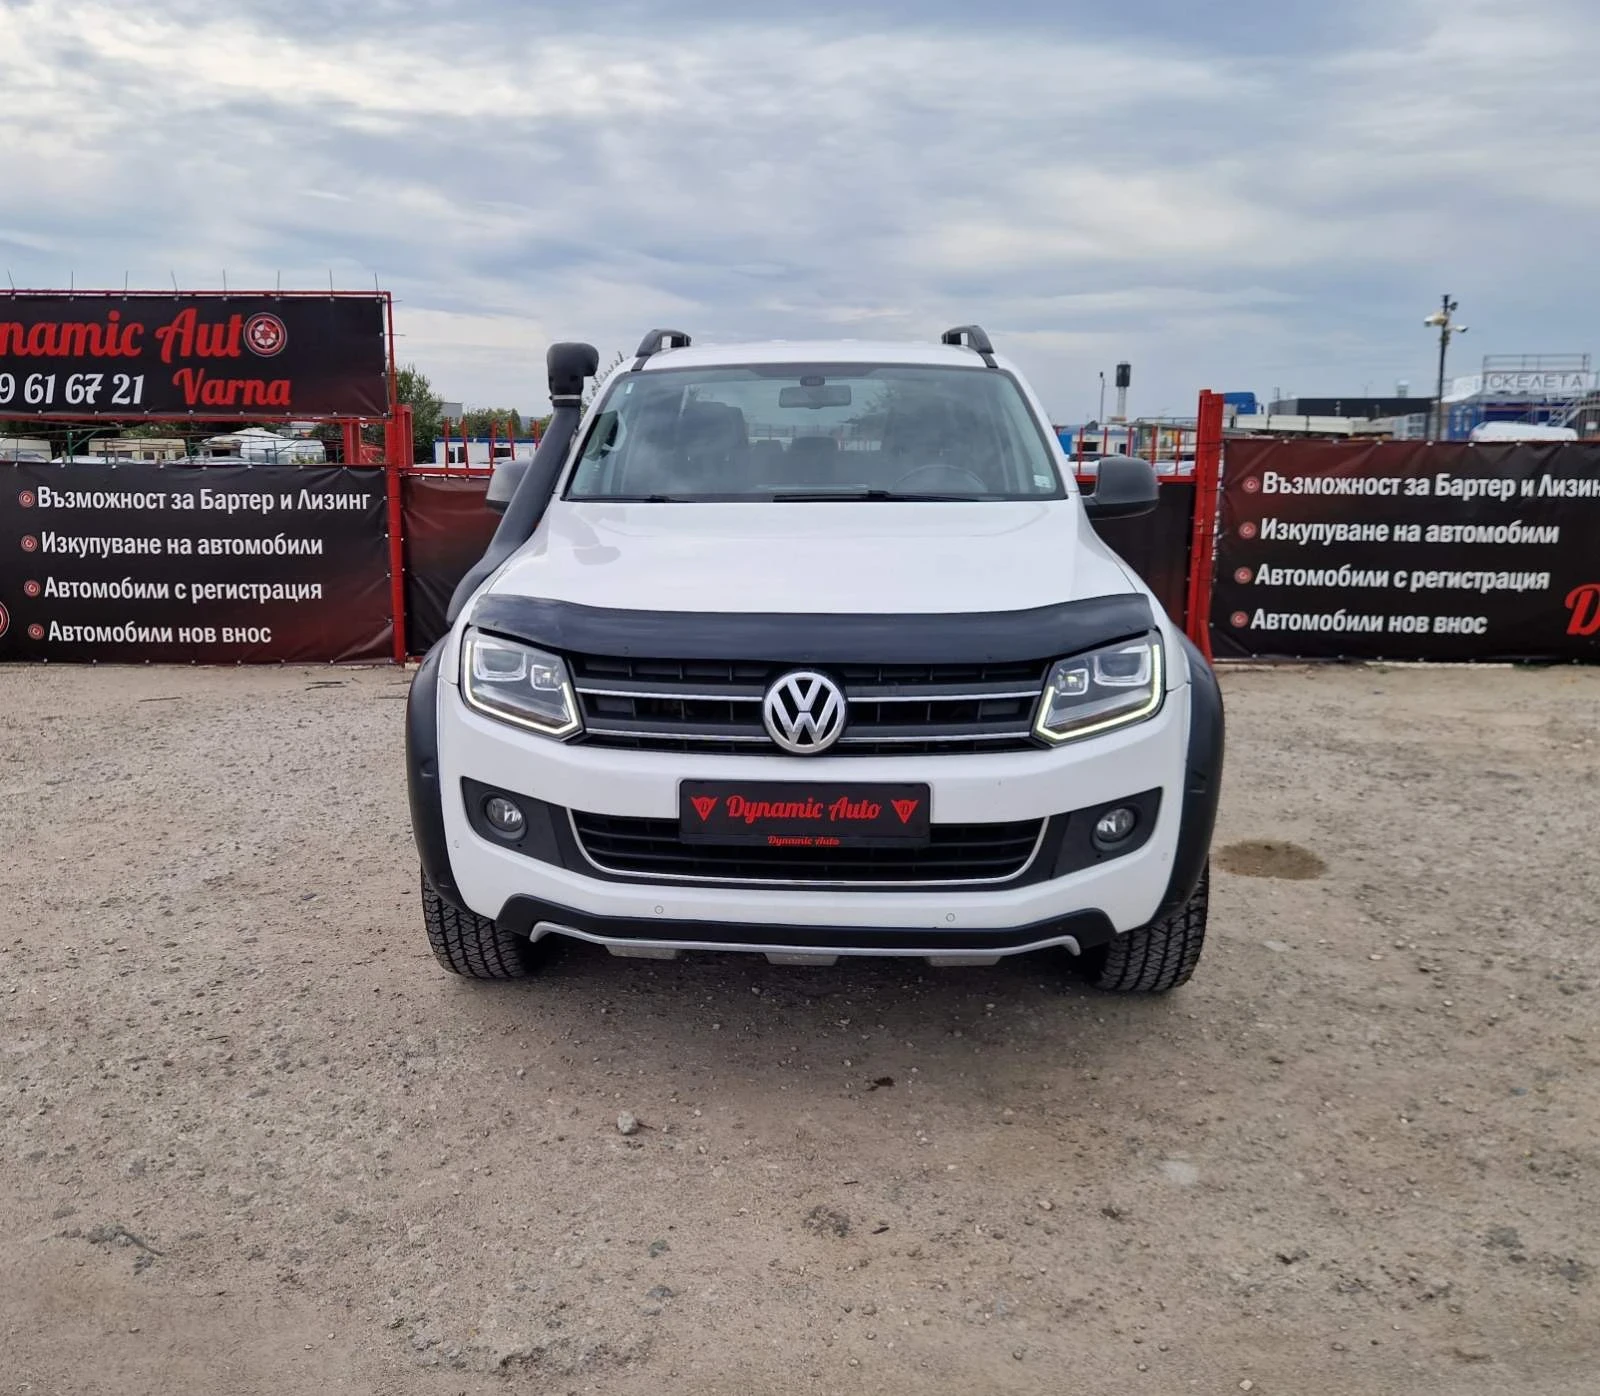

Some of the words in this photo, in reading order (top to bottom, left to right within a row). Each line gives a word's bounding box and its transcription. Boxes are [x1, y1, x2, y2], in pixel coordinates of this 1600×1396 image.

[24, 373, 56, 405] 61
[65, 373, 104, 405] 67
[111, 373, 145, 405] 21
[173, 368, 291, 406] Varna
[1489, 374, 1583, 389] СКЕЛЕТА
[37, 486, 167, 510] Възможност
[170, 492, 195, 510] за
[200, 488, 275, 513] Бартер
[280, 493, 293, 510] и
[297, 488, 371, 510] Лизинг
[1262, 471, 1401, 496] Възможност
[1403, 477, 1430, 496] за
[1434, 472, 1517, 502] Бартер
[1520, 479, 1535, 497] и
[41, 531, 162, 559] Изкупуване
[166, 538, 192, 555] на
[197, 532, 323, 555] автомобили
[1260, 517, 1390, 547] Изкупуване
[1393, 524, 1422, 543] на
[1425, 519, 1560, 544] автомобили
[44, 576, 170, 600] Автомобили
[174, 583, 187, 600] с
[191, 583, 322, 604] регистрация
[1254, 563, 1390, 588] Автомобили
[1393, 570, 1408, 588] с
[1410, 570, 1550, 594] регистрация
[48, 620, 173, 643] Автомобили
[178, 627, 217, 643] нов
[221, 627, 272, 643] внос
[1250, 608, 1384, 632] Автомобили
[1388, 615, 1430, 633] нов
[1433, 616, 1488, 634] внос
[764, 671, 845, 754] VW
[726, 795, 824, 825] Dynamic
[828, 796, 882, 822] Auto
[767, 835, 812, 847] Dynamic
[815, 836, 841, 846] Auto
